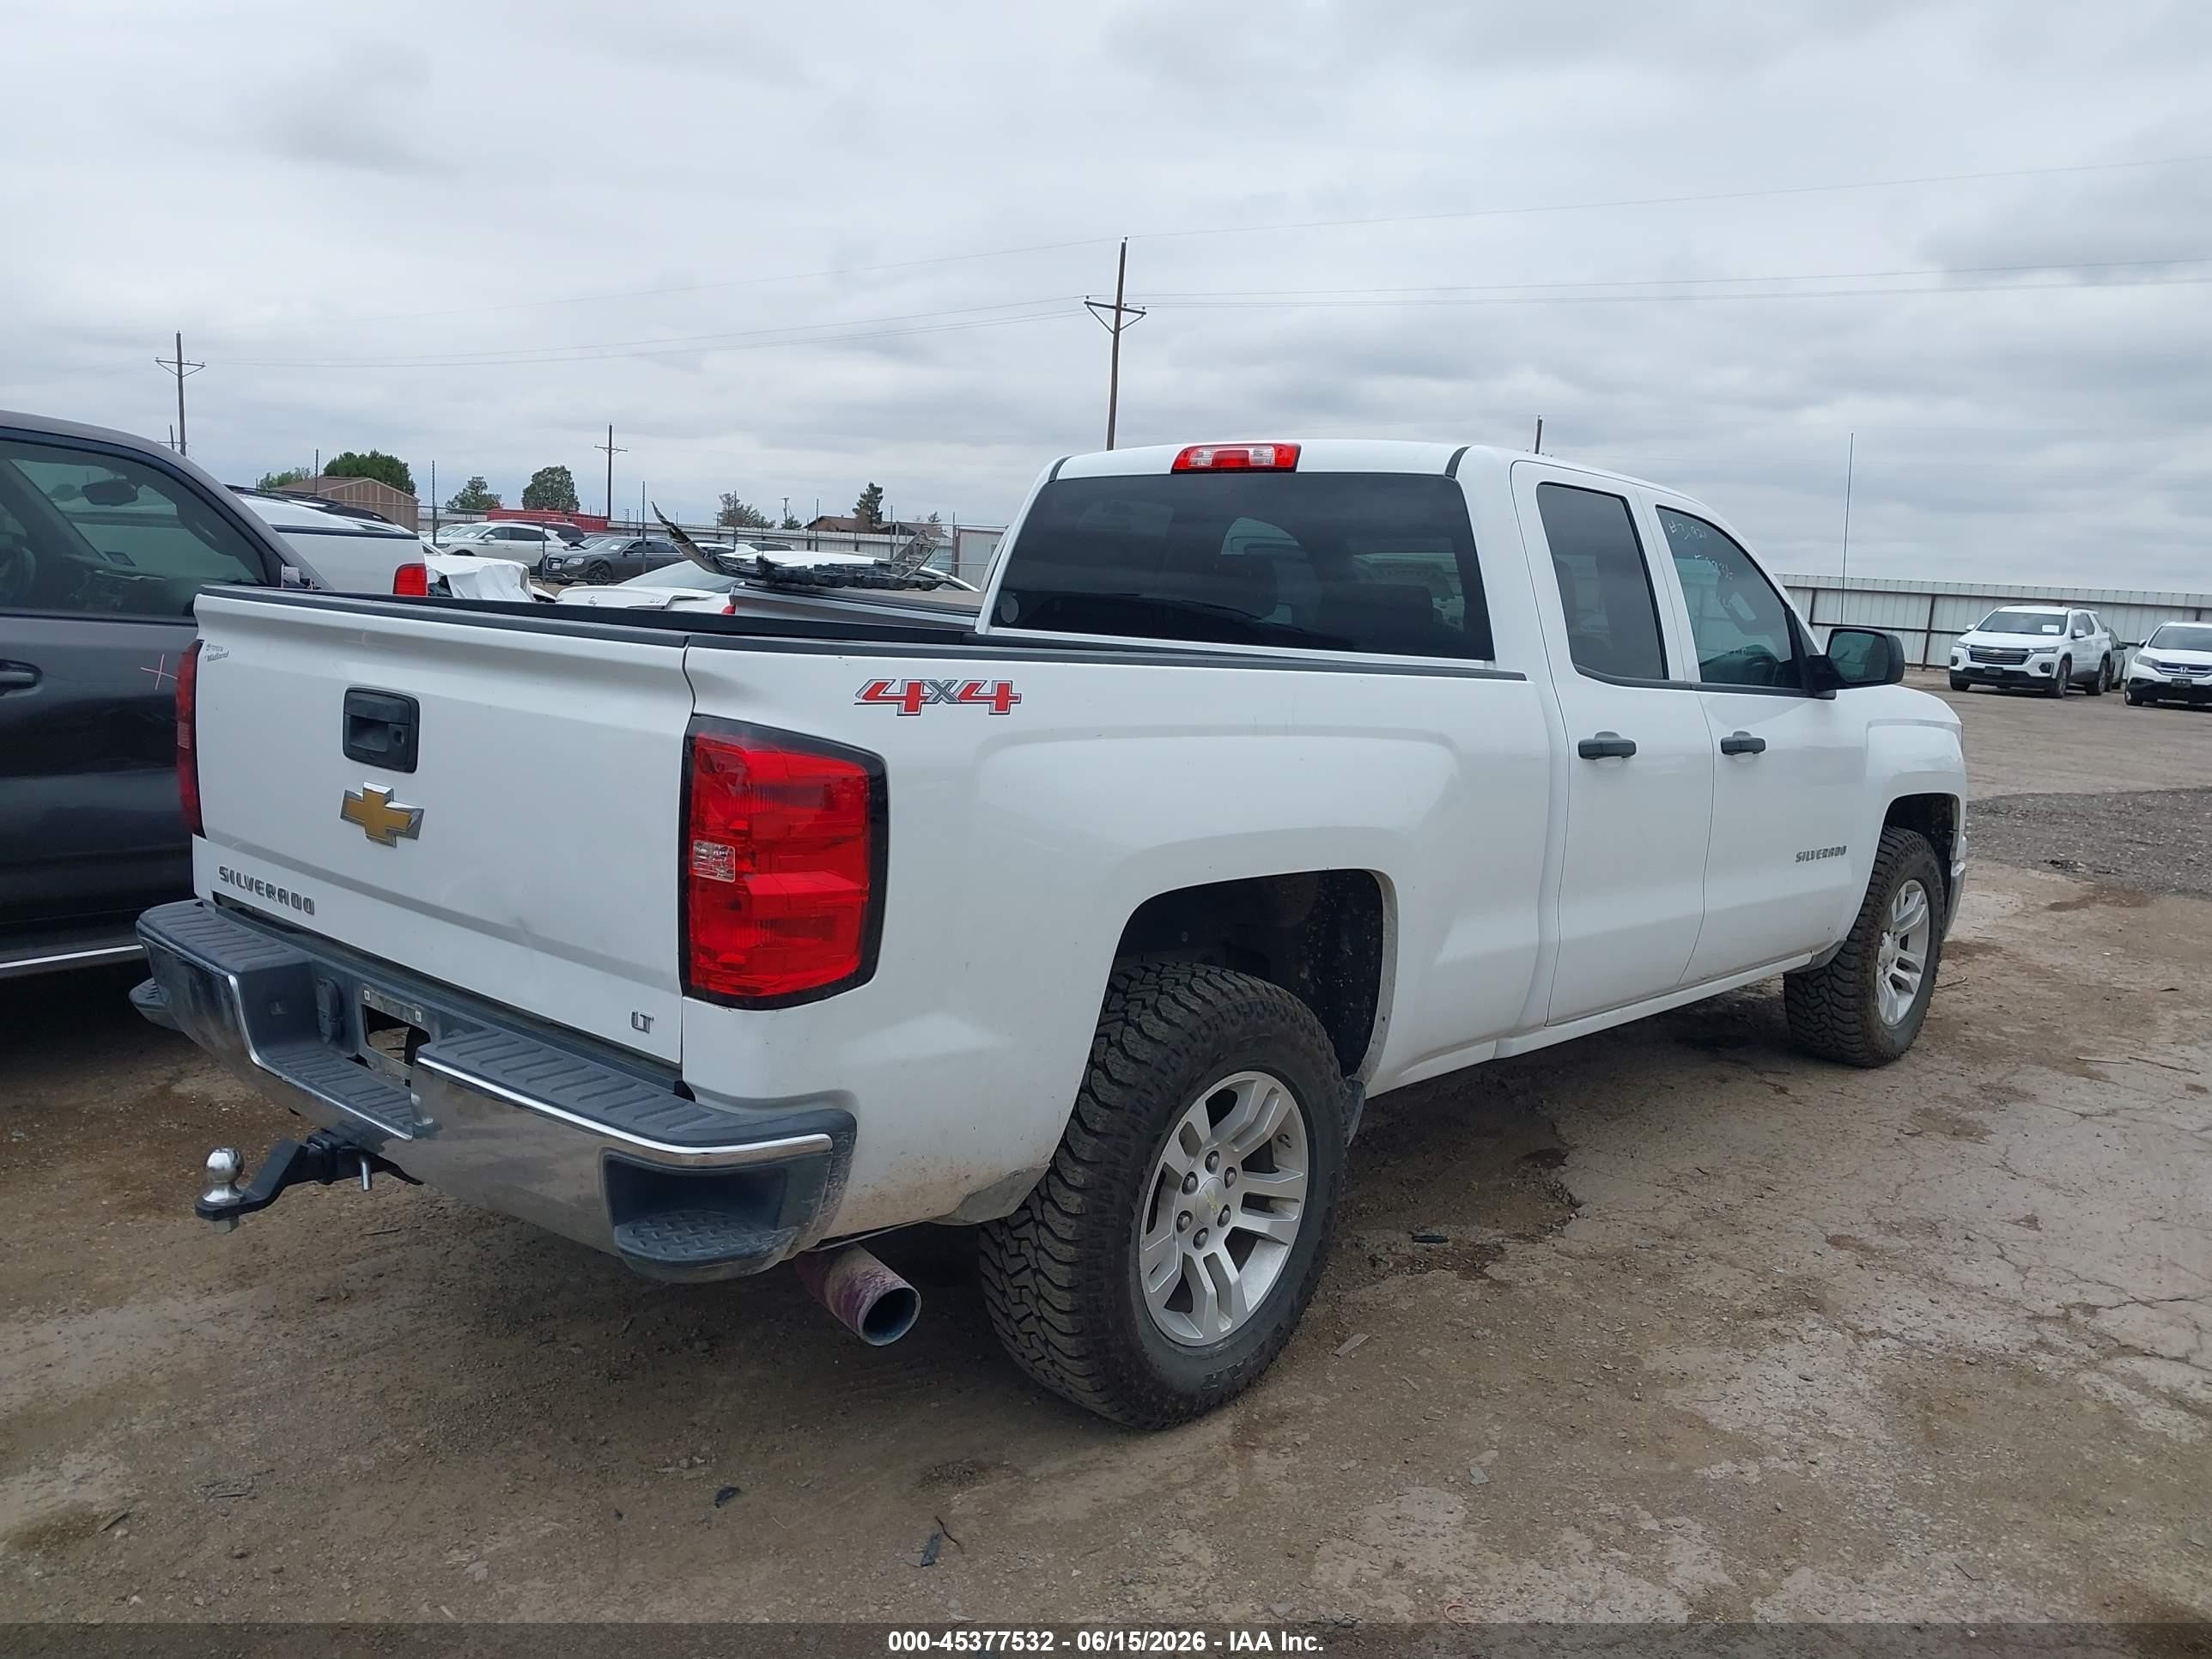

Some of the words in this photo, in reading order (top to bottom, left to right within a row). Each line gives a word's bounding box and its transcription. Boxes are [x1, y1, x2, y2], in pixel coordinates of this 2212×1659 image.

[1795, 845, 1847, 863] SILVERADO
[219, 866, 315, 915] SILVERADO
[631, 1011, 654, 1034] LT
